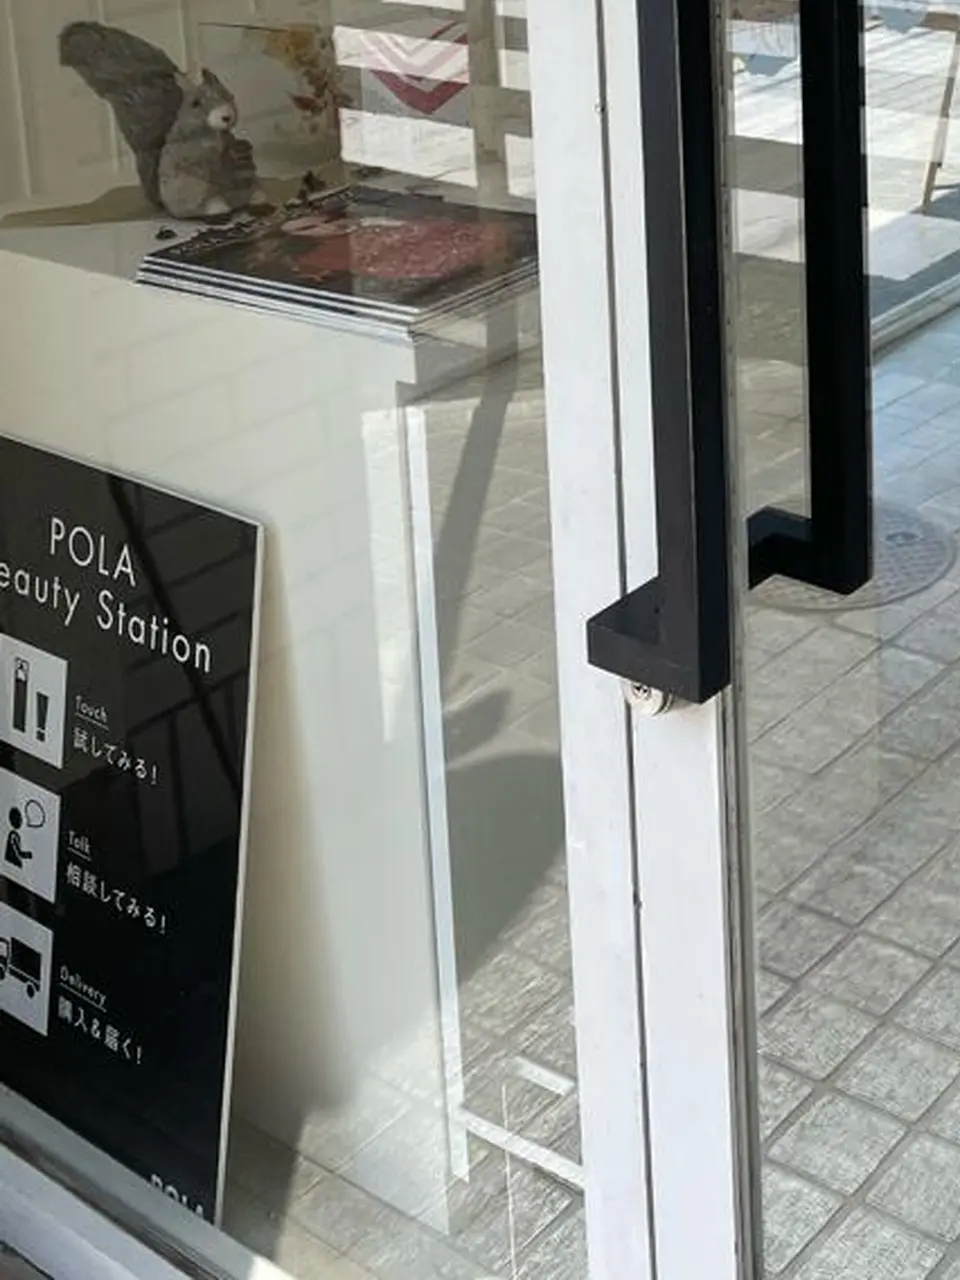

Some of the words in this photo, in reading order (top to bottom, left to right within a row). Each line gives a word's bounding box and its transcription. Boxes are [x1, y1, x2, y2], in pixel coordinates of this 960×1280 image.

[50, 517, 136, 587] POLA
[97, 589, 211, 673] Station
[75, 695, 108, 723] Touch
[69, 830, 91, 855] Talk
[60, 964, 107, 1009] Delivery
